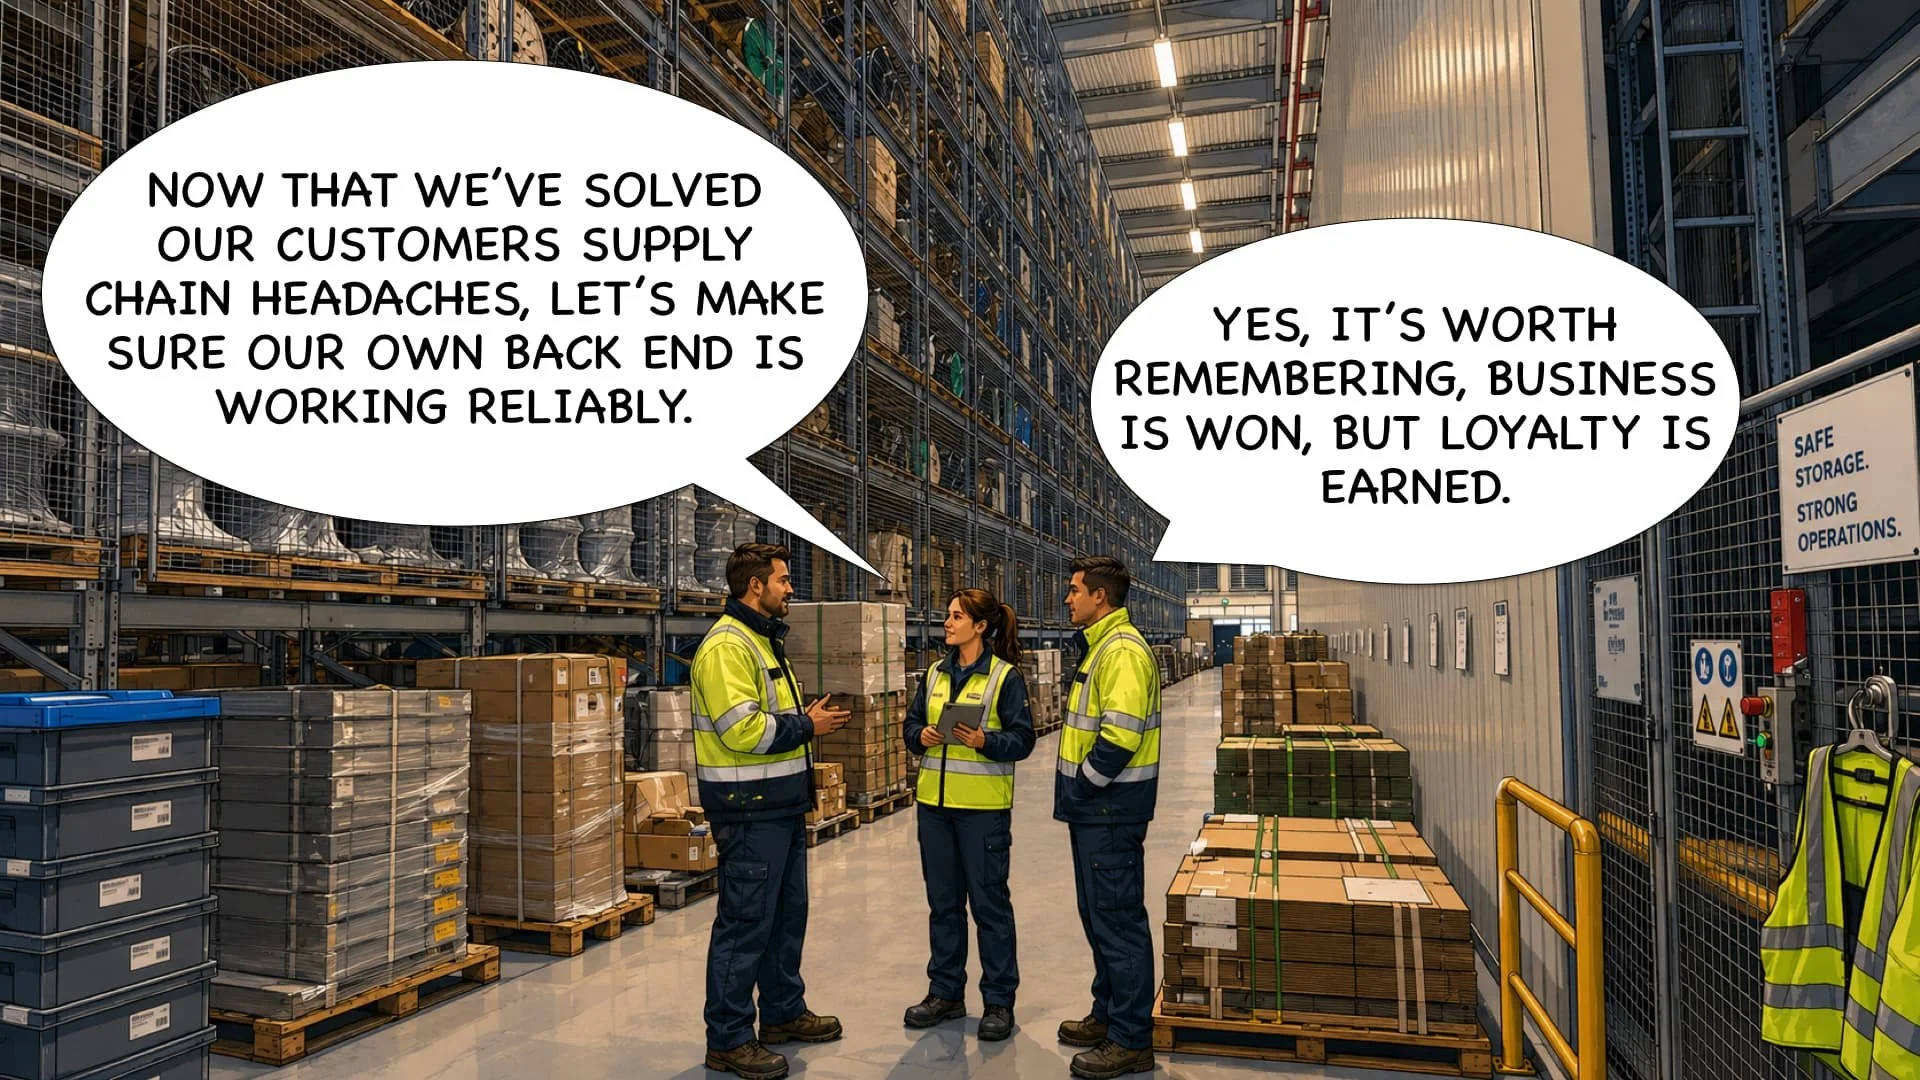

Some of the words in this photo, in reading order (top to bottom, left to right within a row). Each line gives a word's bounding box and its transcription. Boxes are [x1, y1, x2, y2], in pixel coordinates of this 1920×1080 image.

[1794, 426, 1834, 458] SAFE
[1795, 450, 1869, 488] STORAGE.
[1797, 492, 1857, 523] STRONG
[1798, 517, 1902, 552] OPERATIONS.
